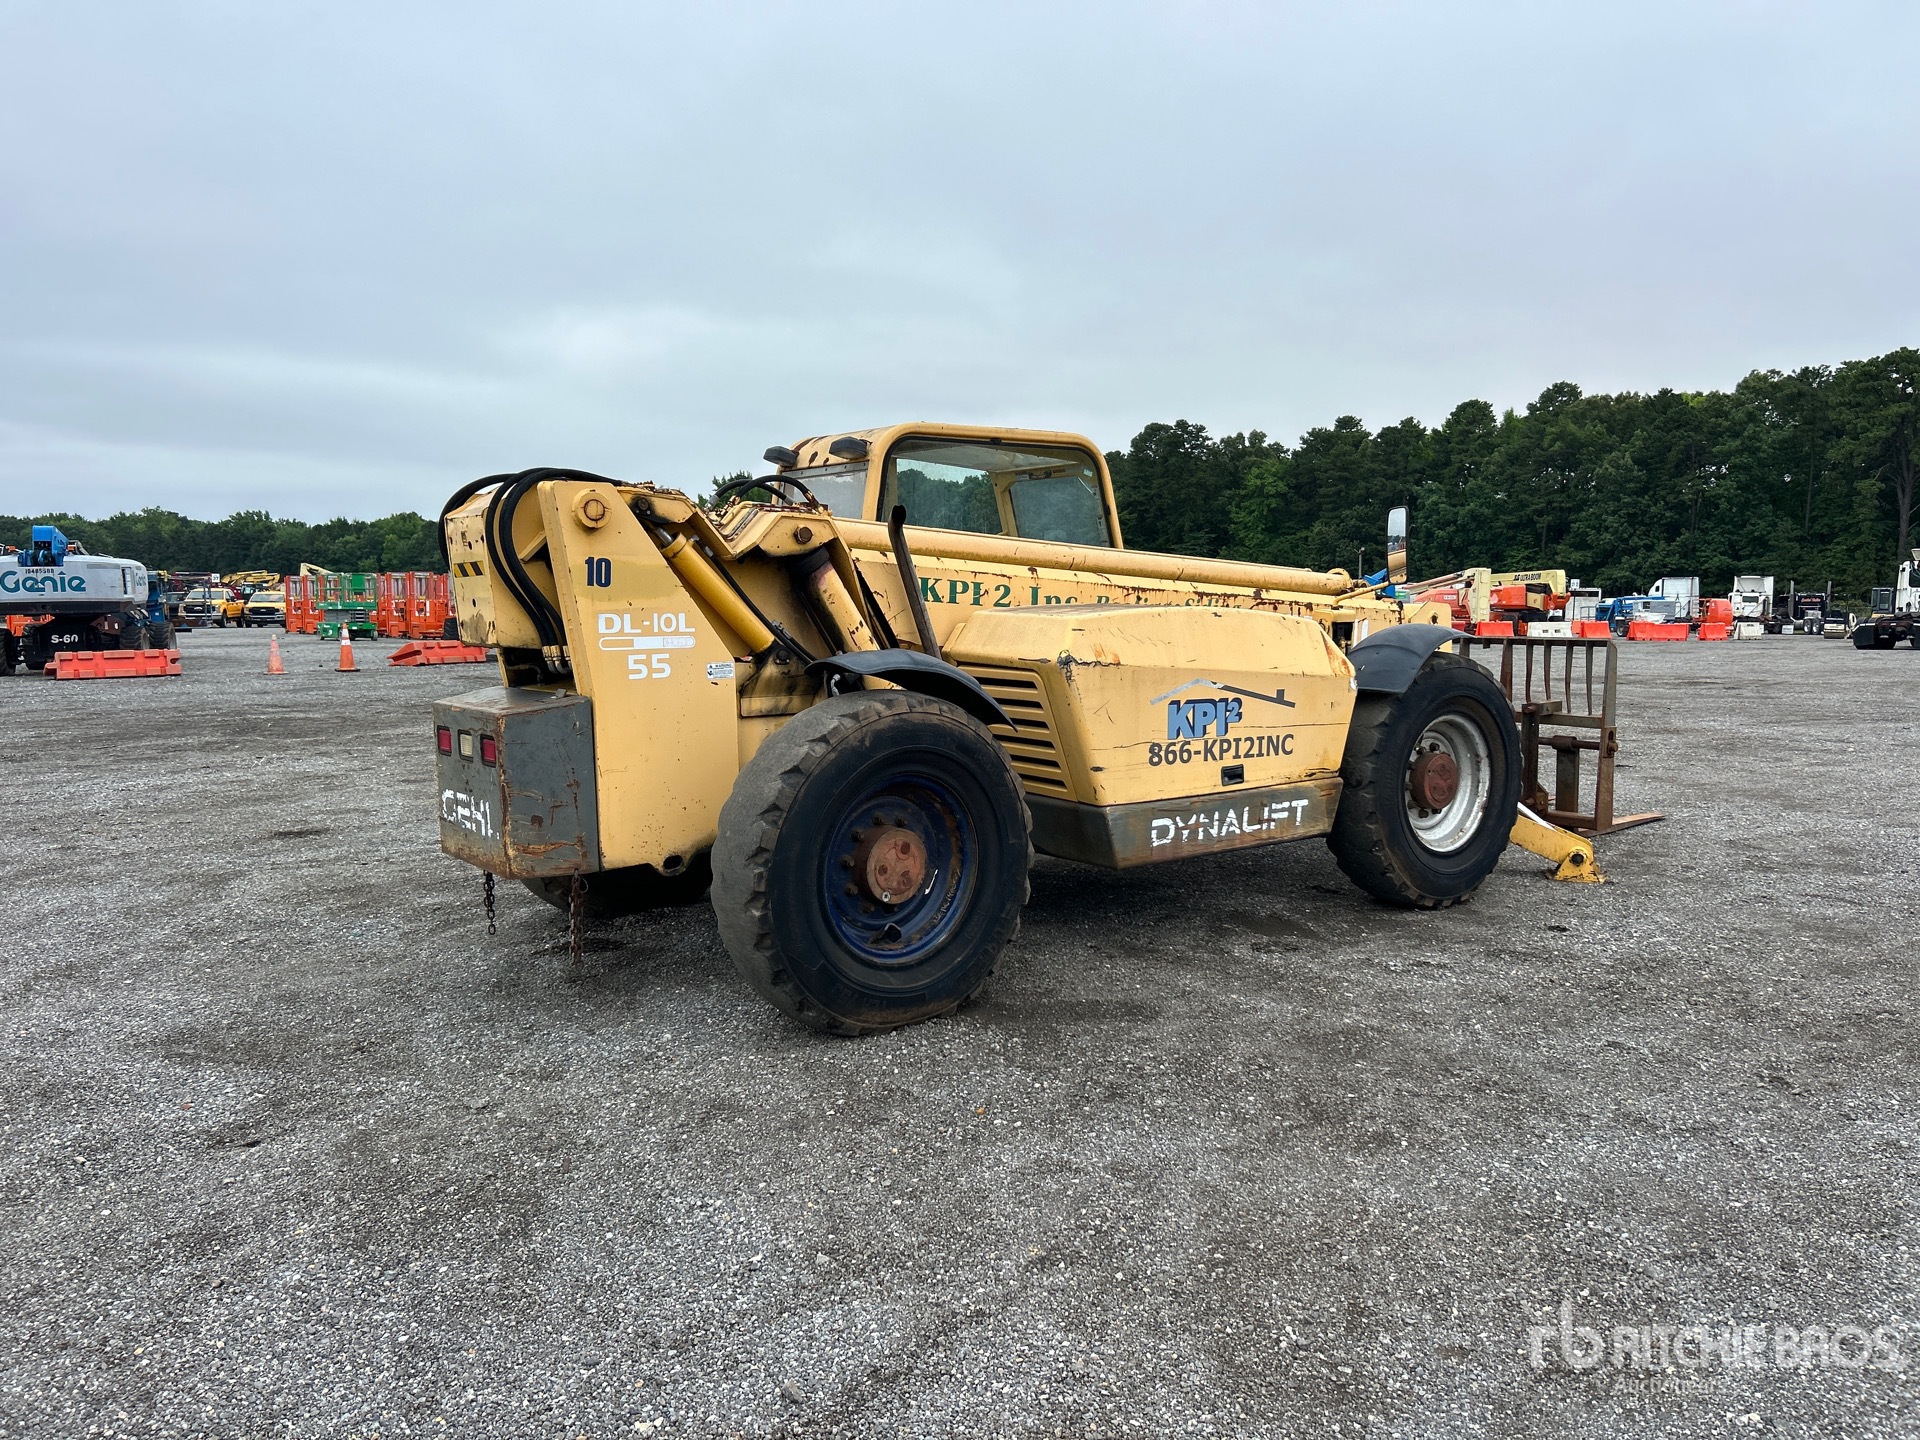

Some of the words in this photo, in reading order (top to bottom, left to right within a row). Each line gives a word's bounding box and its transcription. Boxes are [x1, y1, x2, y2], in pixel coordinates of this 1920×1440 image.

[0, 570, 87, 594] Genie
[585, 557, 612, 588] 10
[597, 612, 696, 634] DL-10L
[51, 634, 79, 644] S-60
[628, 653, 671, 680] 55
[1148, 733, 1294, 767] 866-KPI2INC
[1150, 798, 1309, 848] DYNALIFT
